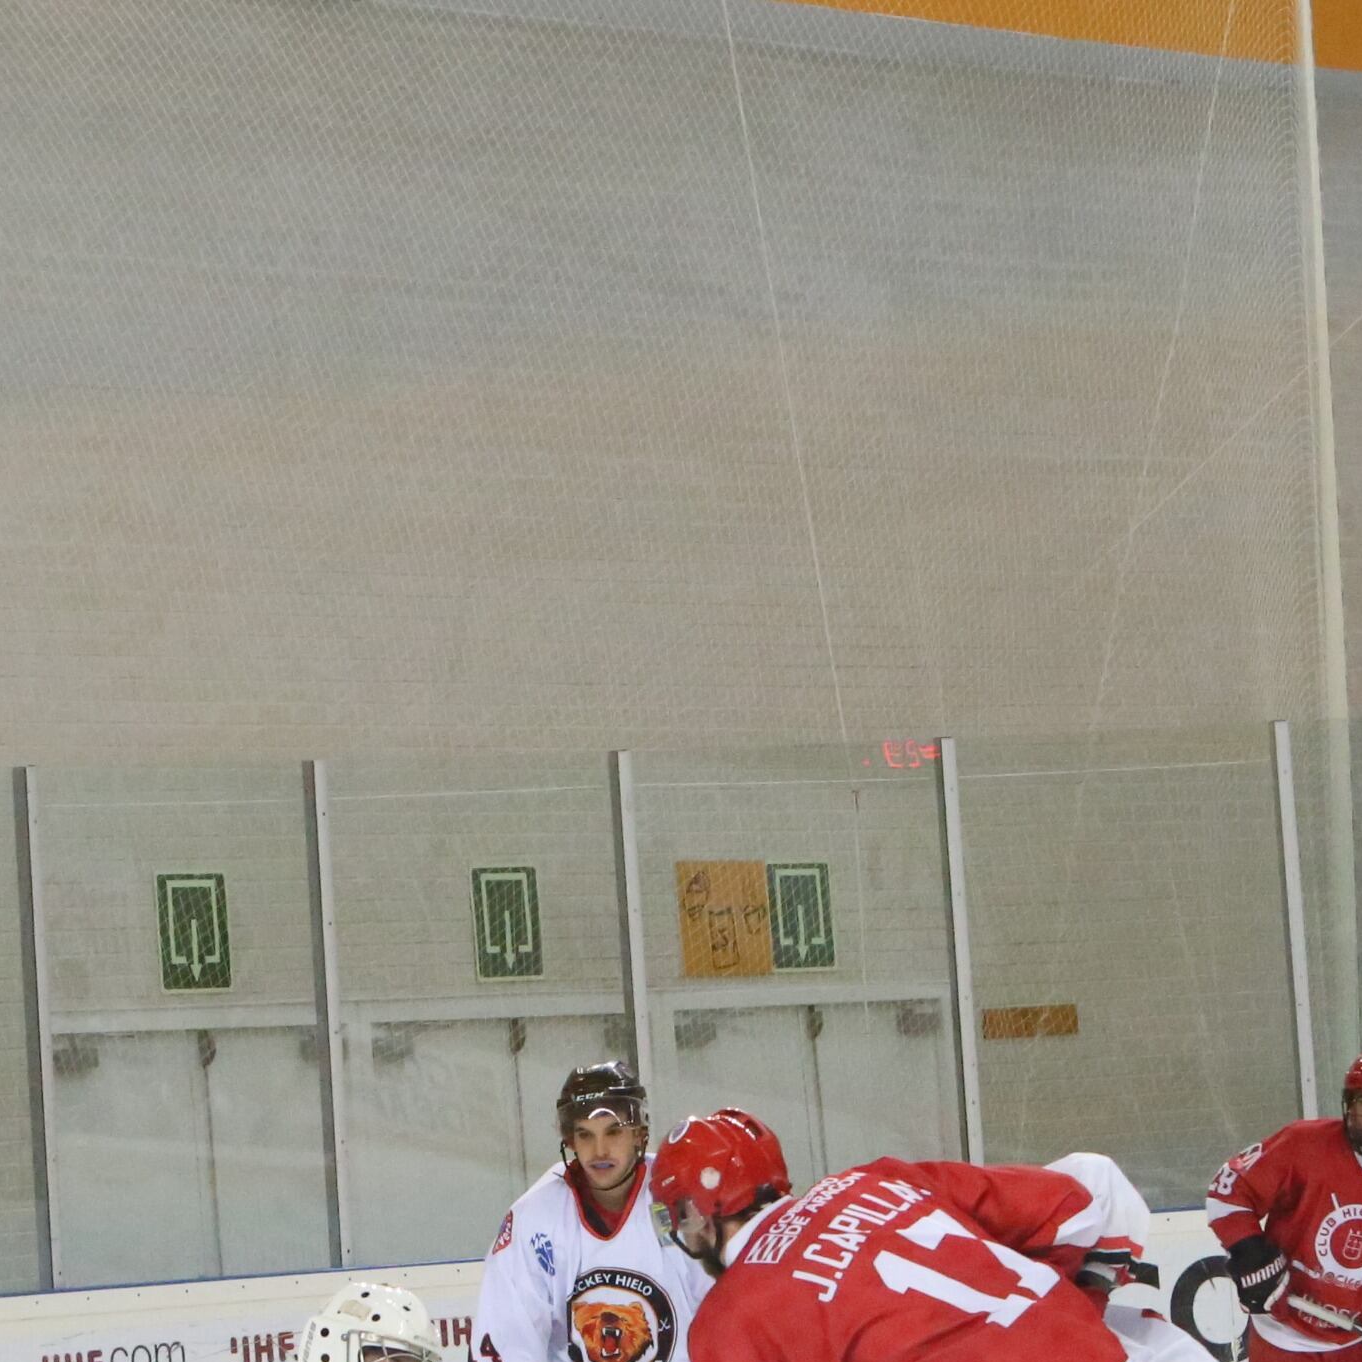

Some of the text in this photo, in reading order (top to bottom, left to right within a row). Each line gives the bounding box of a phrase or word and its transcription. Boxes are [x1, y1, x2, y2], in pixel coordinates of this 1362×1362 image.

[575, 1091, 605, 1102] CCM
[785, 1215, 812, 1236] DE
[1317, 1216, 1338, 1258] CLUB
[872, 1208, 1062, 1329] 17
[615, 1274, 653, 1297] HIELO
